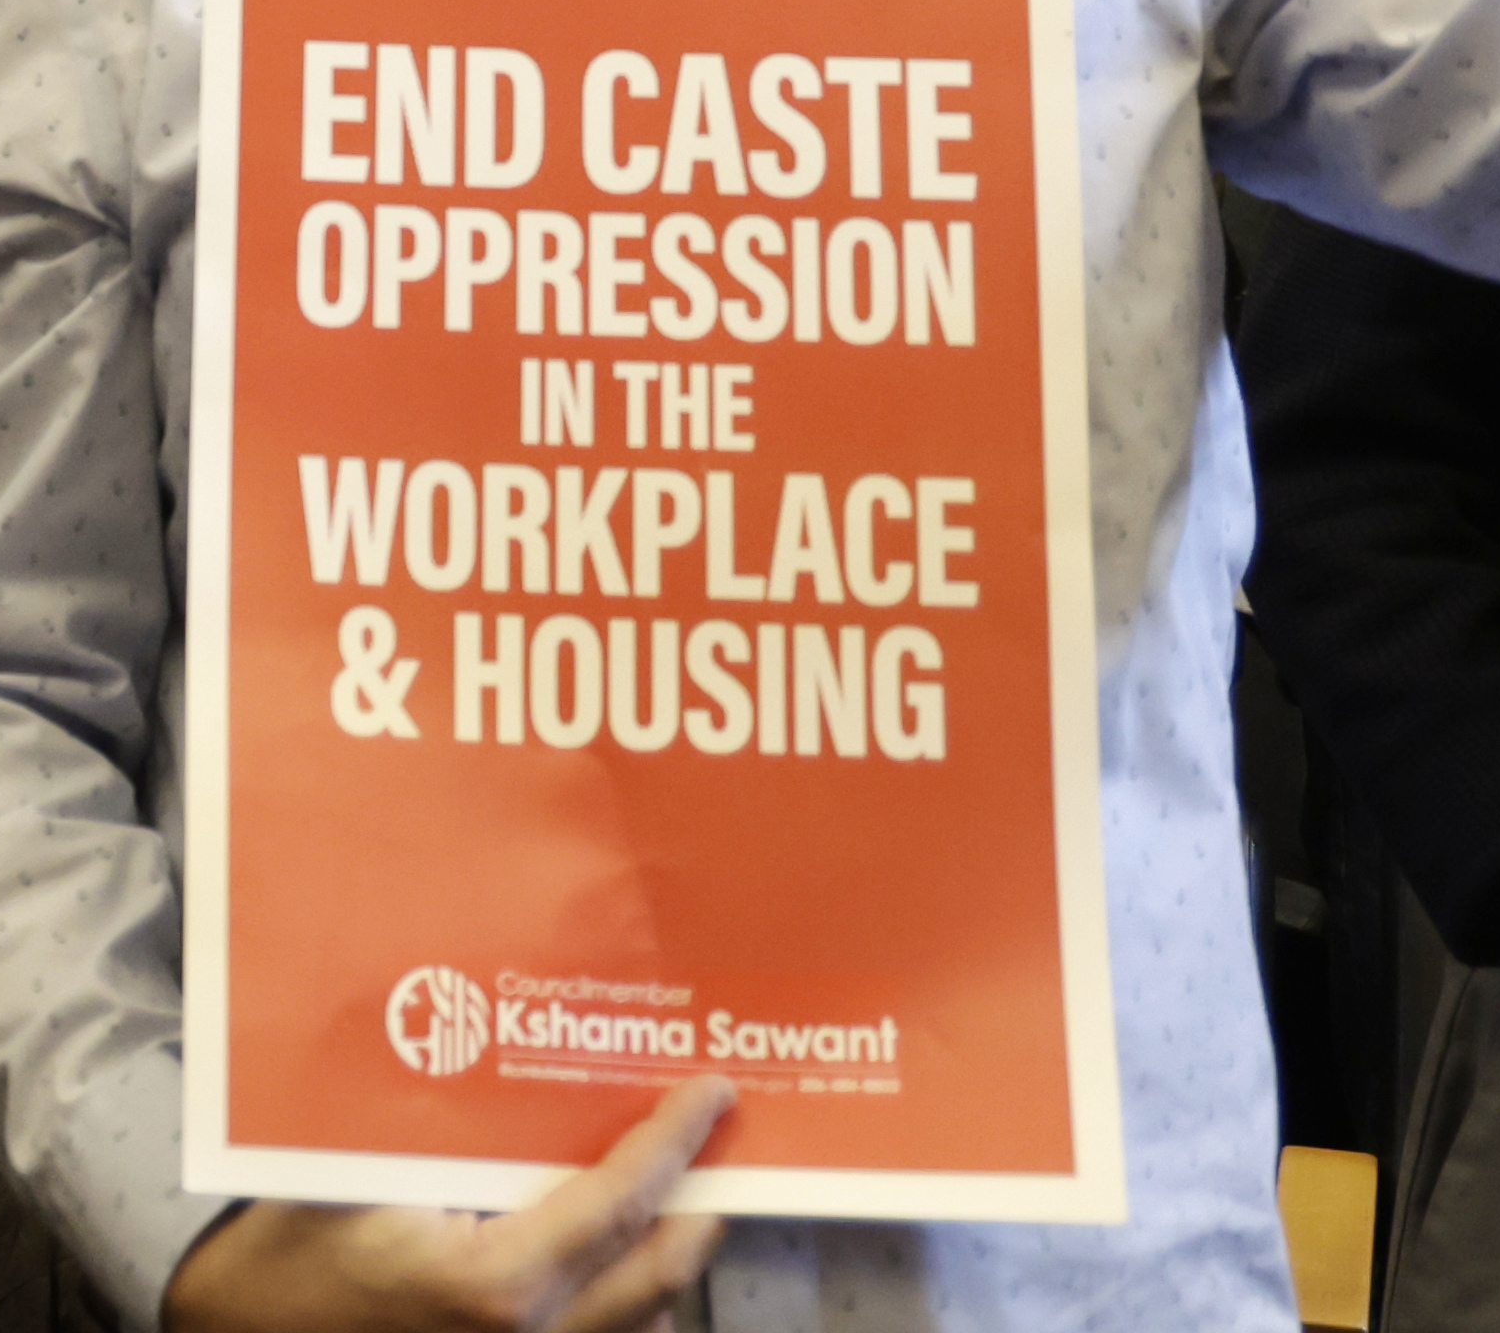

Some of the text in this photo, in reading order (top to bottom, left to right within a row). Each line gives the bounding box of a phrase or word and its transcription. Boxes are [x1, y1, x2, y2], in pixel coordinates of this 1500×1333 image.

[300, 39, 979, 202] END CASTE
[295, 199, 977, 347] OPPRESSION
[520, 357, 756, 452] IN THE
[297, 453, 980, 608] WORKPLACE
[329, 604, 947, 762] & HOUSING
[496, 999, 899, 1064] Kshama Sawant
